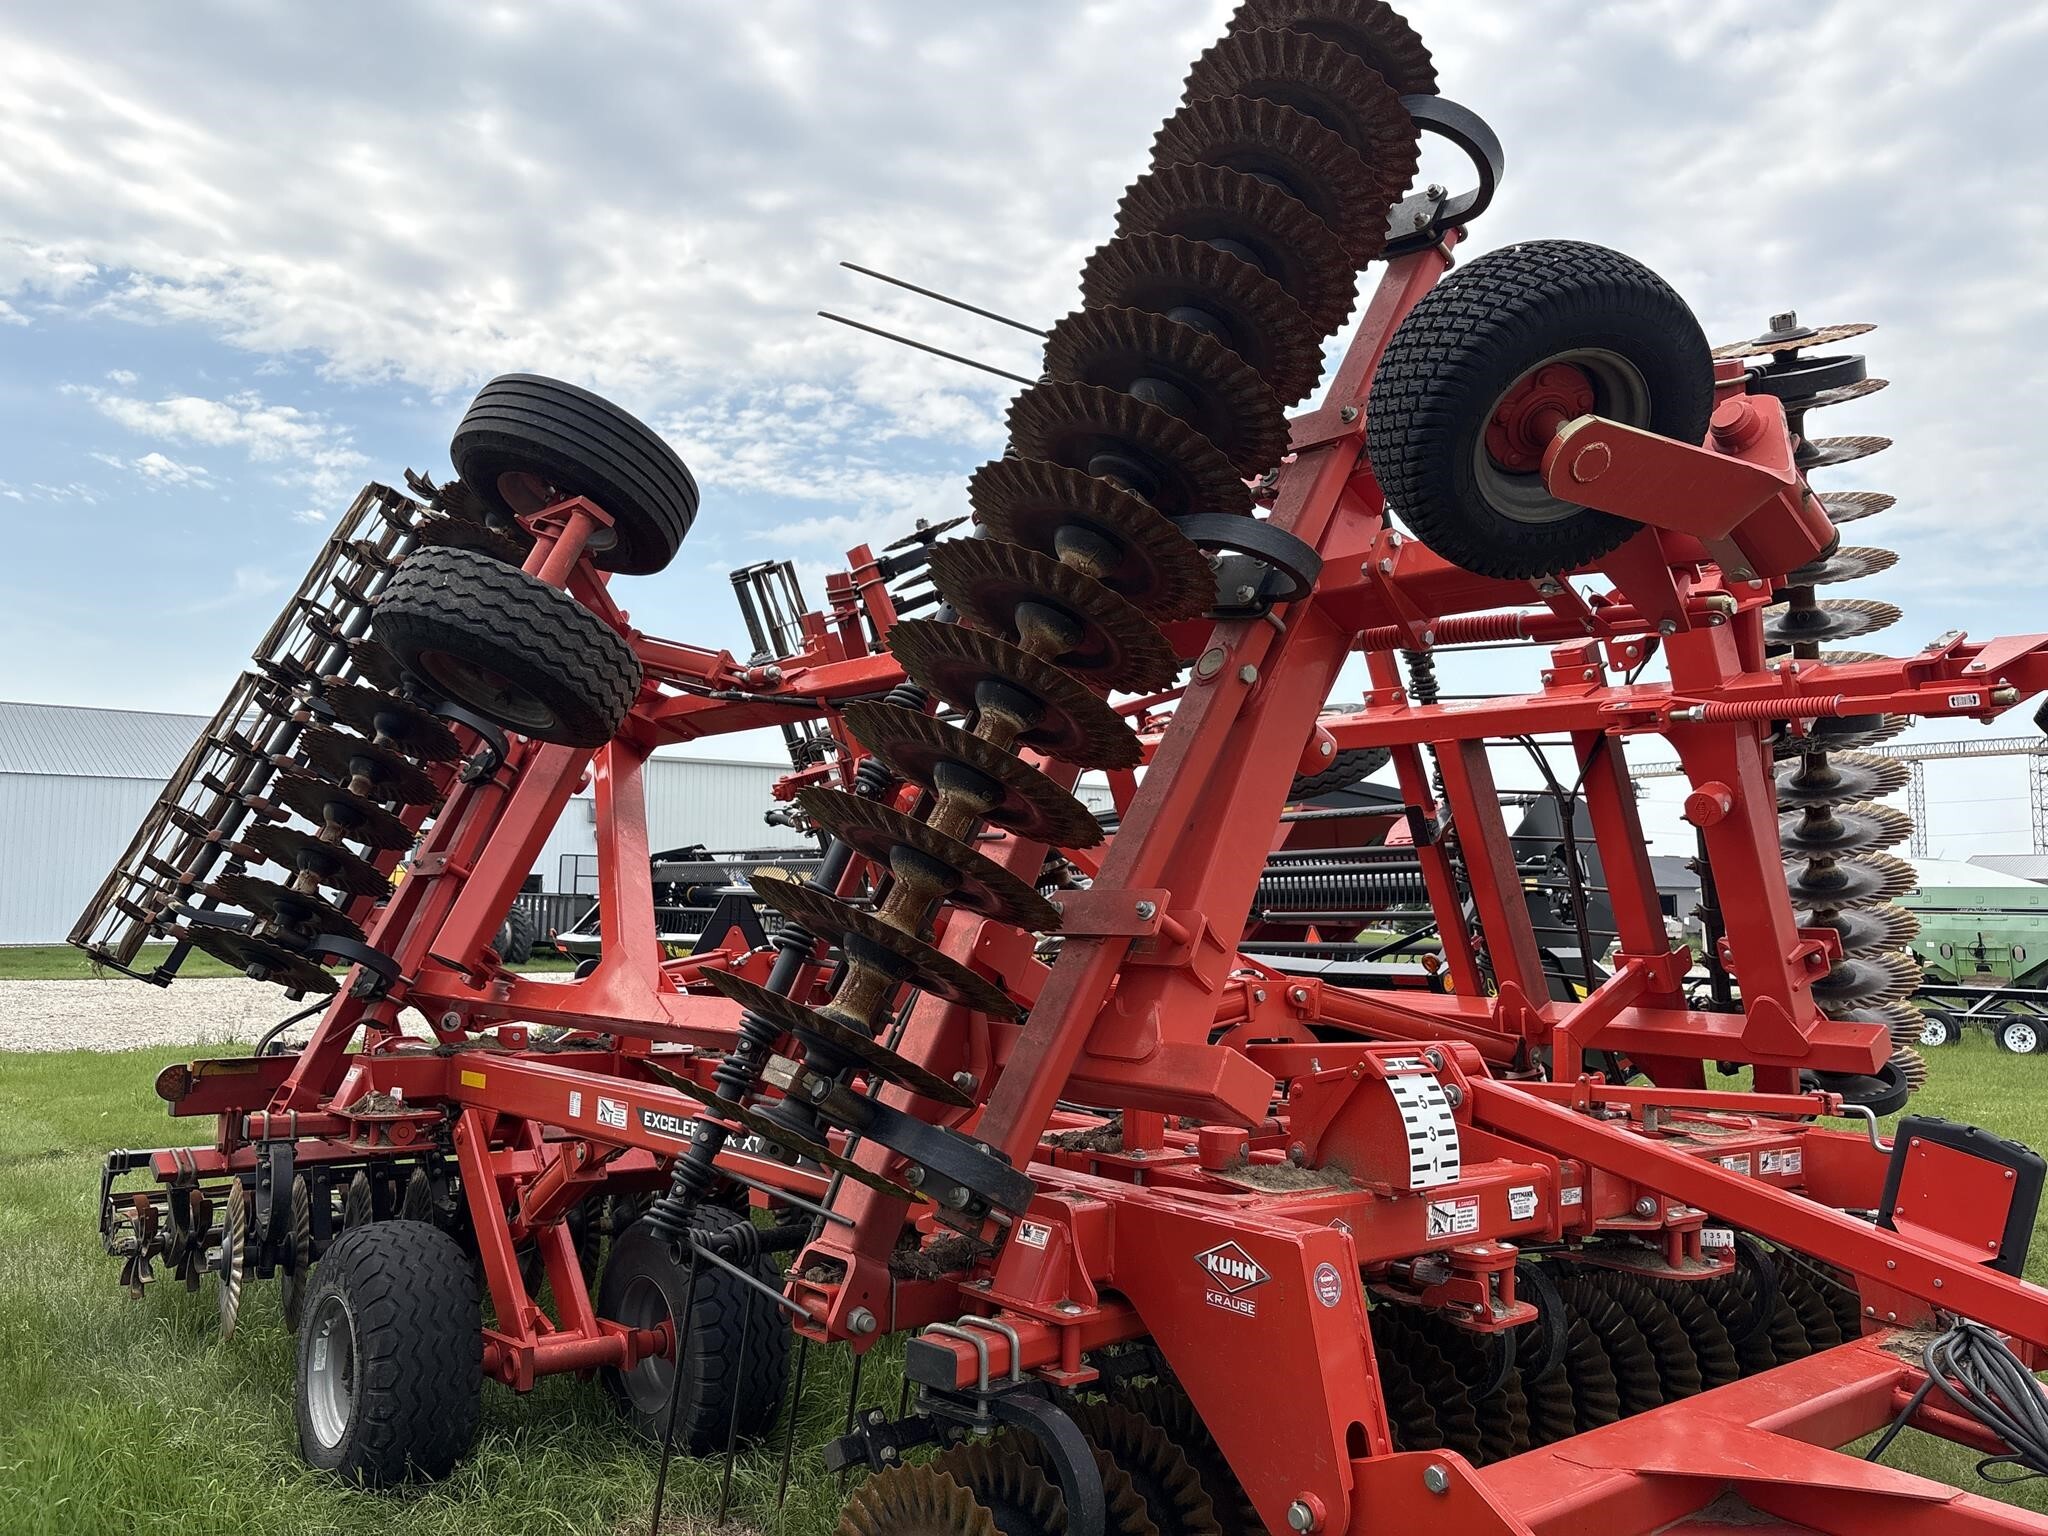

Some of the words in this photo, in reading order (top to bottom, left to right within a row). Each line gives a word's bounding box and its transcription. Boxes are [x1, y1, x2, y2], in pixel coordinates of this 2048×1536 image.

[1418, 1094, 1428, 1110] 5
[1428, 1126, 1437, 1142] 3
[1432, 1156, 1438, 1173] 1
[1726, 1232, 1731, 1240] 8
[1207, 1253, 1257, 1282] KUHN
[1206, 1291, 1256, 1315] KRAUSE
